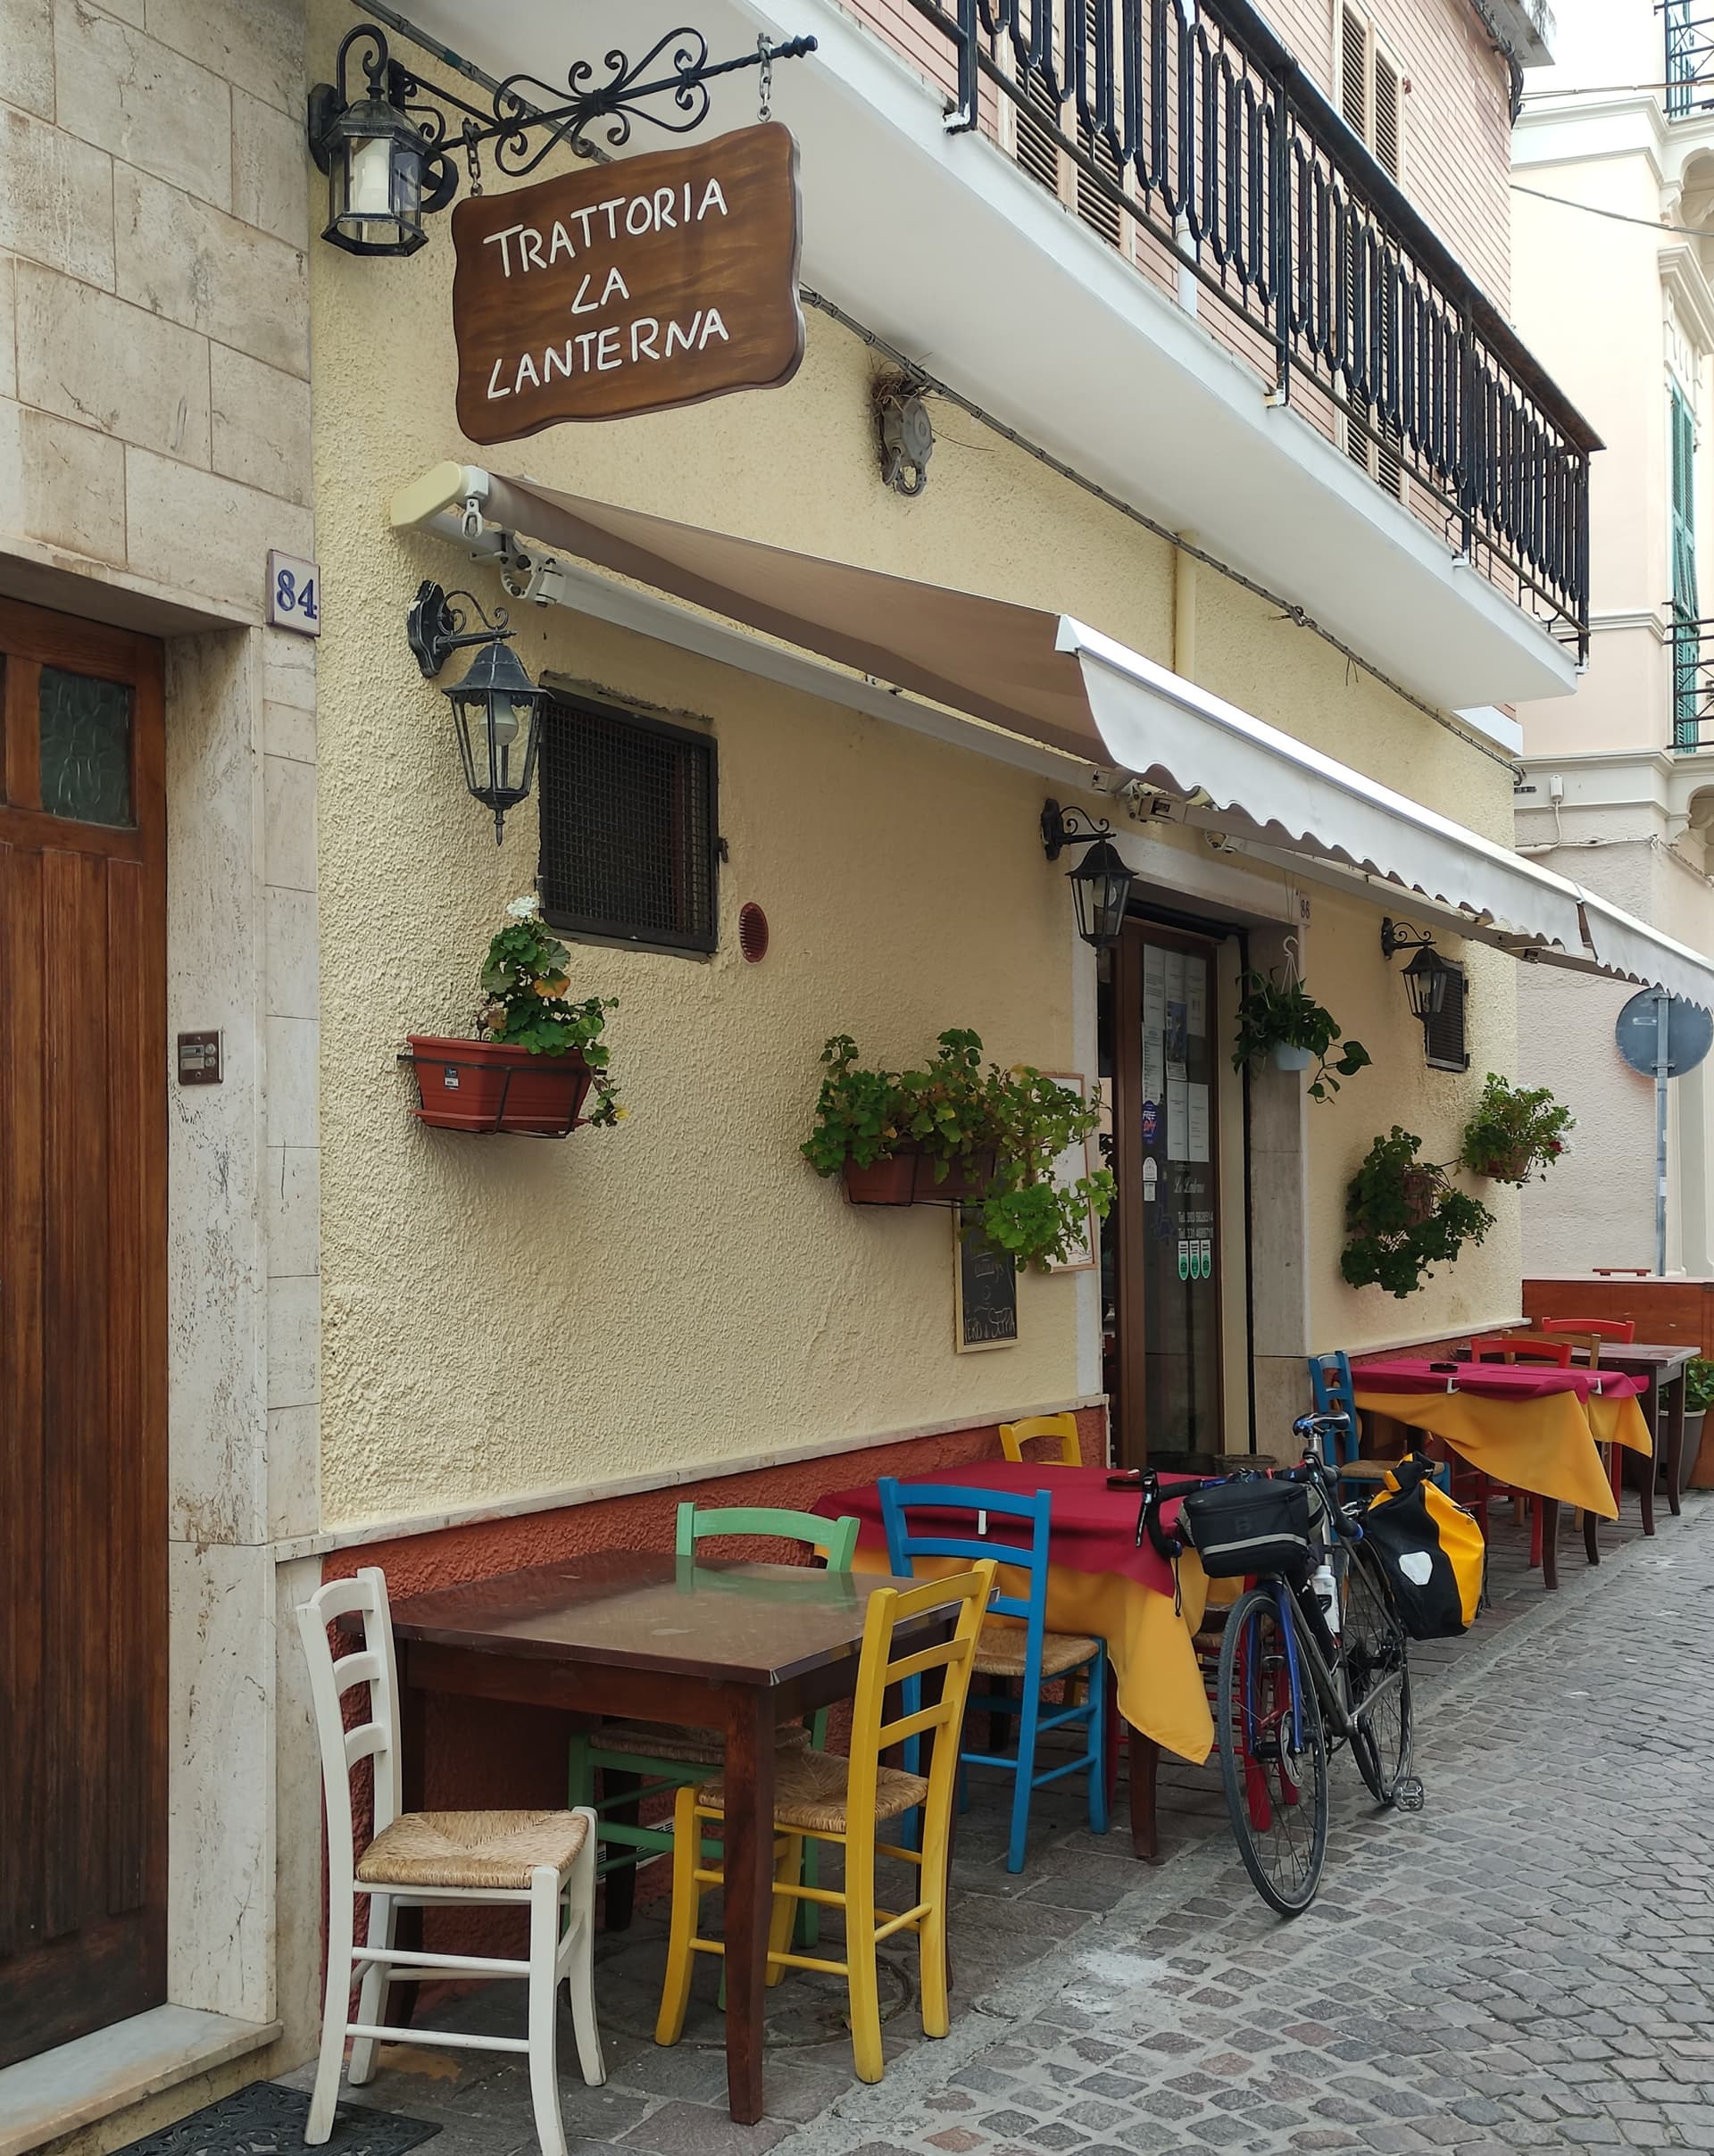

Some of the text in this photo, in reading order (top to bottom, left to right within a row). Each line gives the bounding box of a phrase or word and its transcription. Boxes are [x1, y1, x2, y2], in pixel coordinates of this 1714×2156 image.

[483, 178, 728, 278] TRATTORIA
[570, 267, 629, 314] LA
[487, 308, 730, 400] LANTERNA
[276, 569, 318, 620] 84
